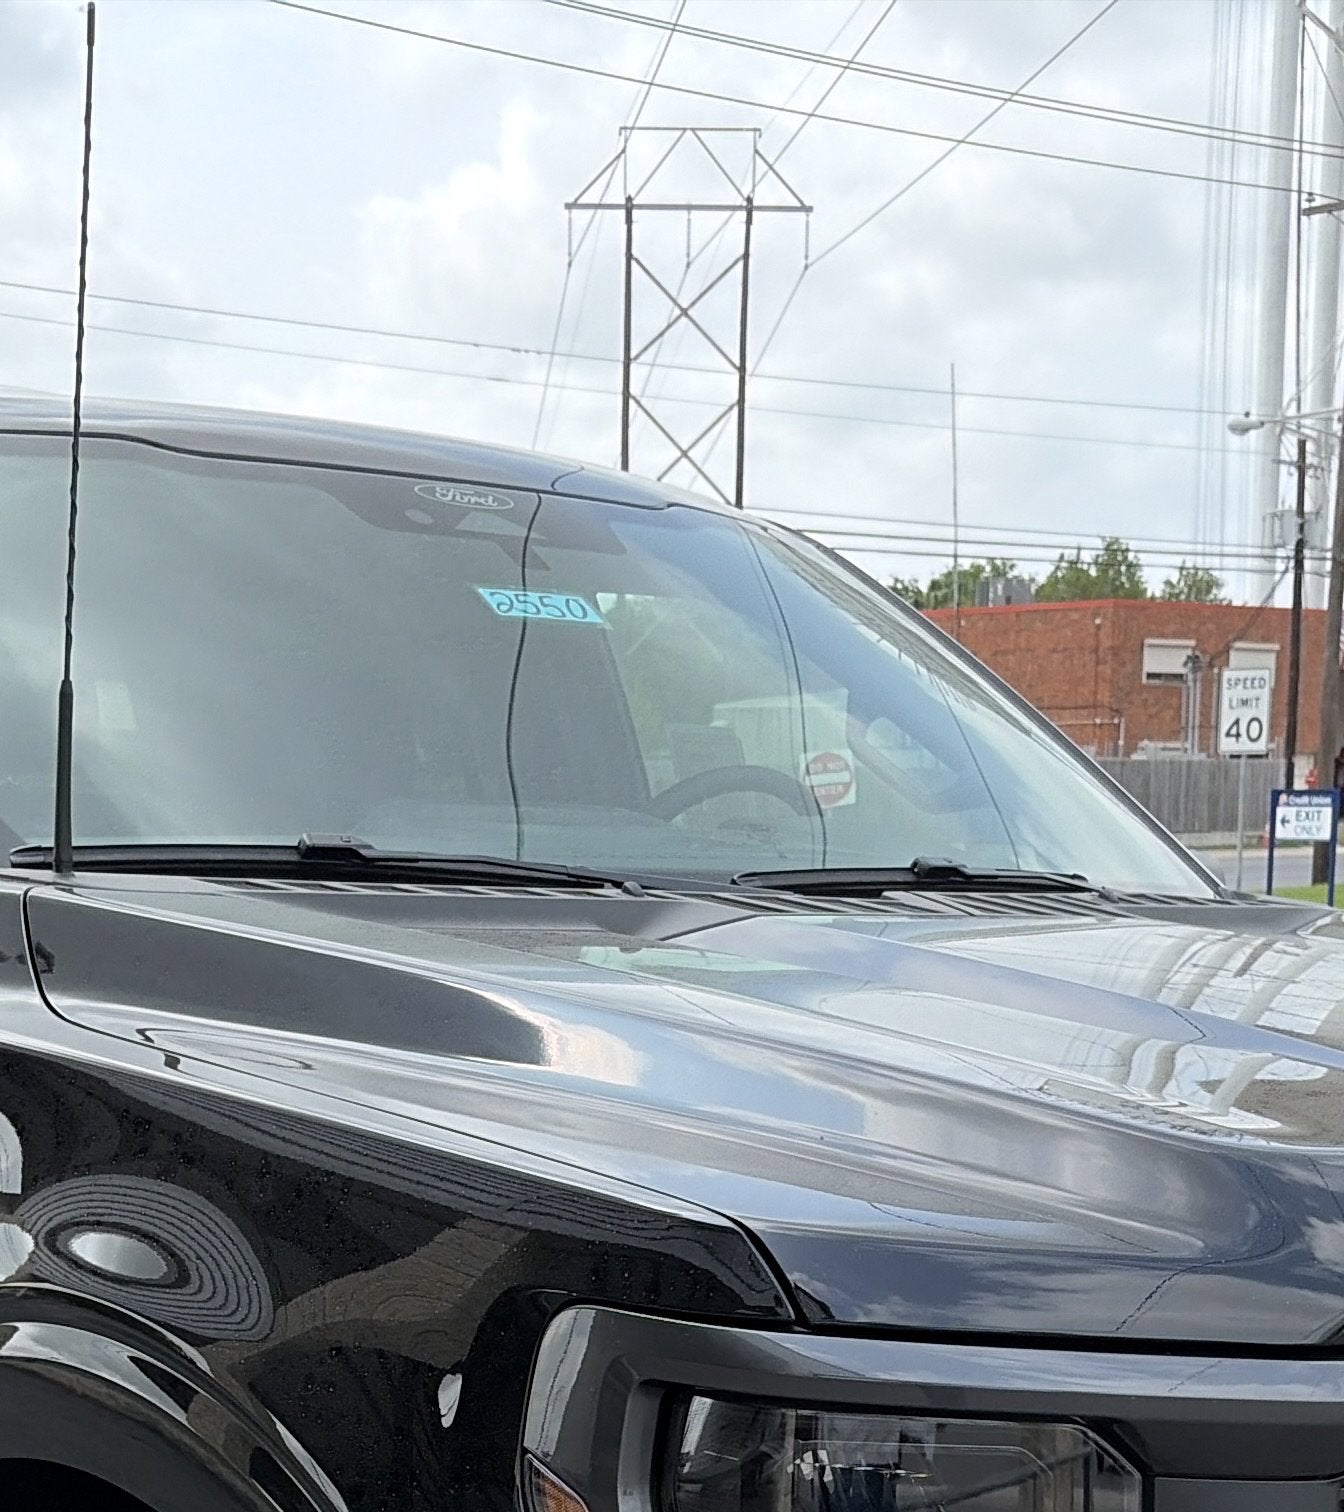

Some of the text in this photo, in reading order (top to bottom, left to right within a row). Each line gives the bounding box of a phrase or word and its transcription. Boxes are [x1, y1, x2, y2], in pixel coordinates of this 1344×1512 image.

[434, 486, 499, 507] Ford
[487, 591, 588, 620] 2550
[1226, 677, 1267, 691] SPEED
[1228, 697, 1261, 711] LIMIT
[1224, 717, 1264, 743] 40
[1295, 810, 1323, 822] EXIT
[1294, 825, 1322, 837] ONLY
